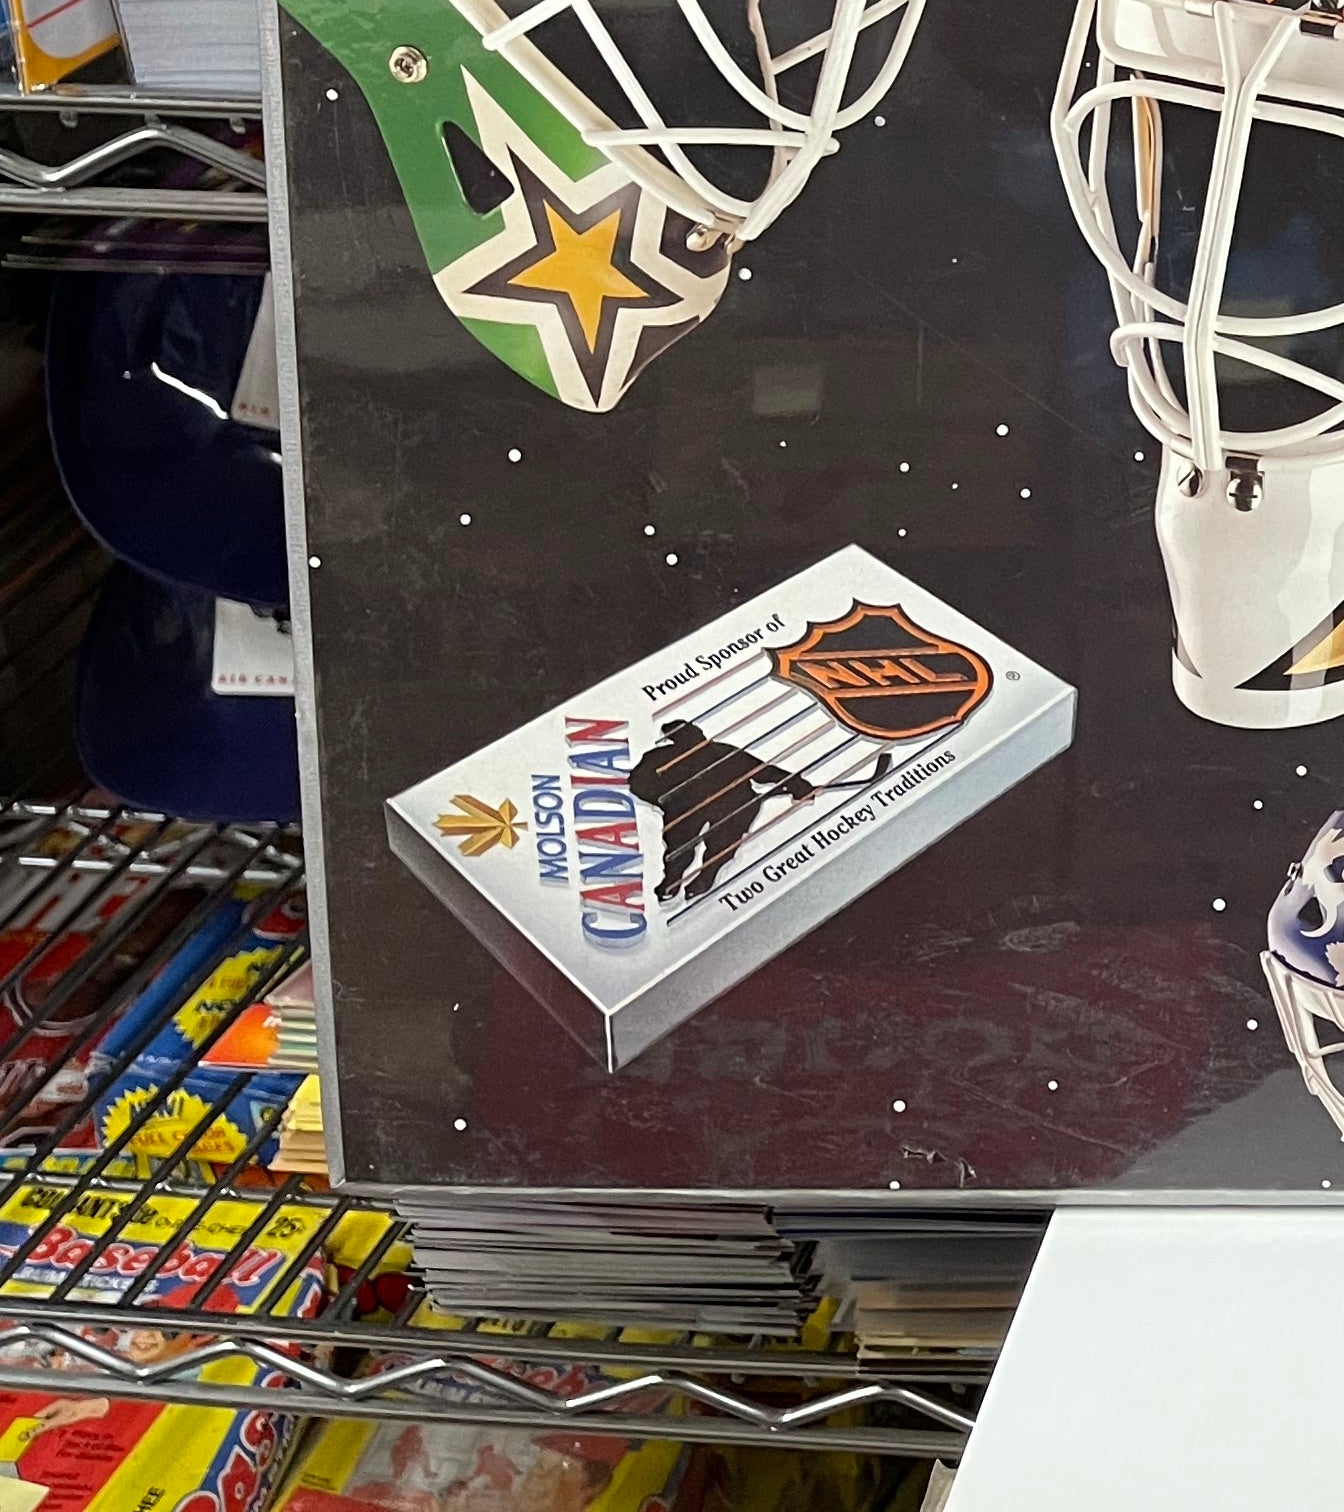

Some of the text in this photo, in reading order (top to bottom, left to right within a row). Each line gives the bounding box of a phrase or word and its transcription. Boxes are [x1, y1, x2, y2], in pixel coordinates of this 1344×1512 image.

[642, 613, 786, 701] Proud Sponsor of
[796, 657, 970, 691] NHL
[531, 774, 569, 885] MOLSON
[565, 716, 648, 942] CANADIAN
[719, 750, 957, 912] Two Great Hockey Traditions
